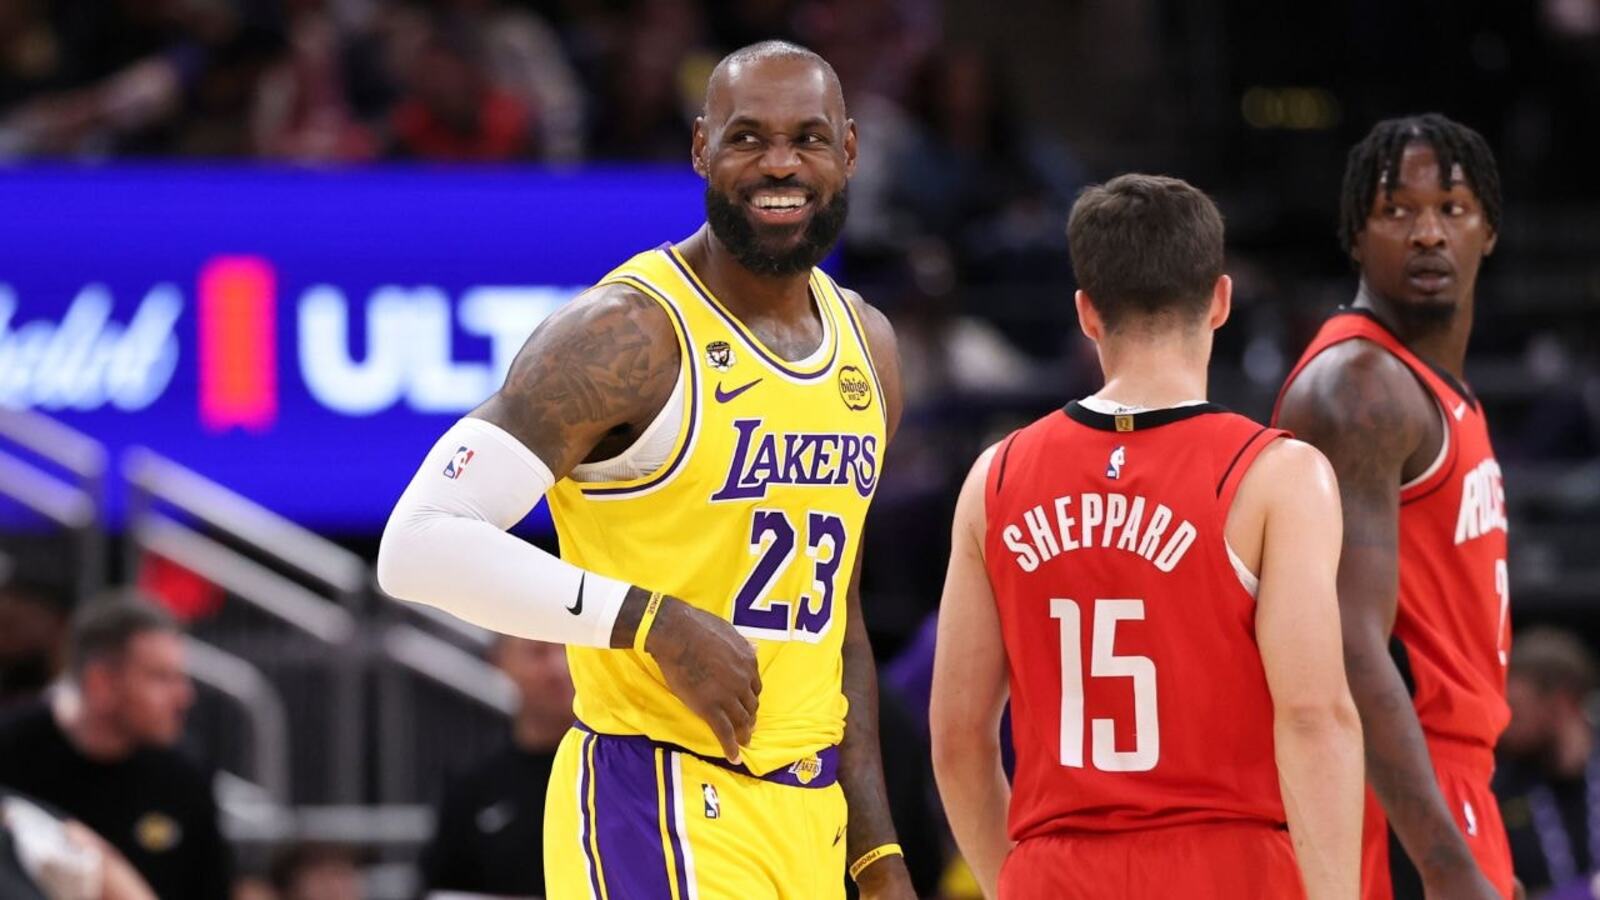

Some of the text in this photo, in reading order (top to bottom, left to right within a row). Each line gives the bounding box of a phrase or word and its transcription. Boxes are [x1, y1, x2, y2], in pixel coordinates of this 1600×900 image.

[840, 377, 868, 397] bibigo
[711, 419, 877, 501] LAKERS
[1002, 492, 1197, 573] SHEPPARD
[732, 509, 847, 642] 23
[1049, 598, 1160, 772] 15
